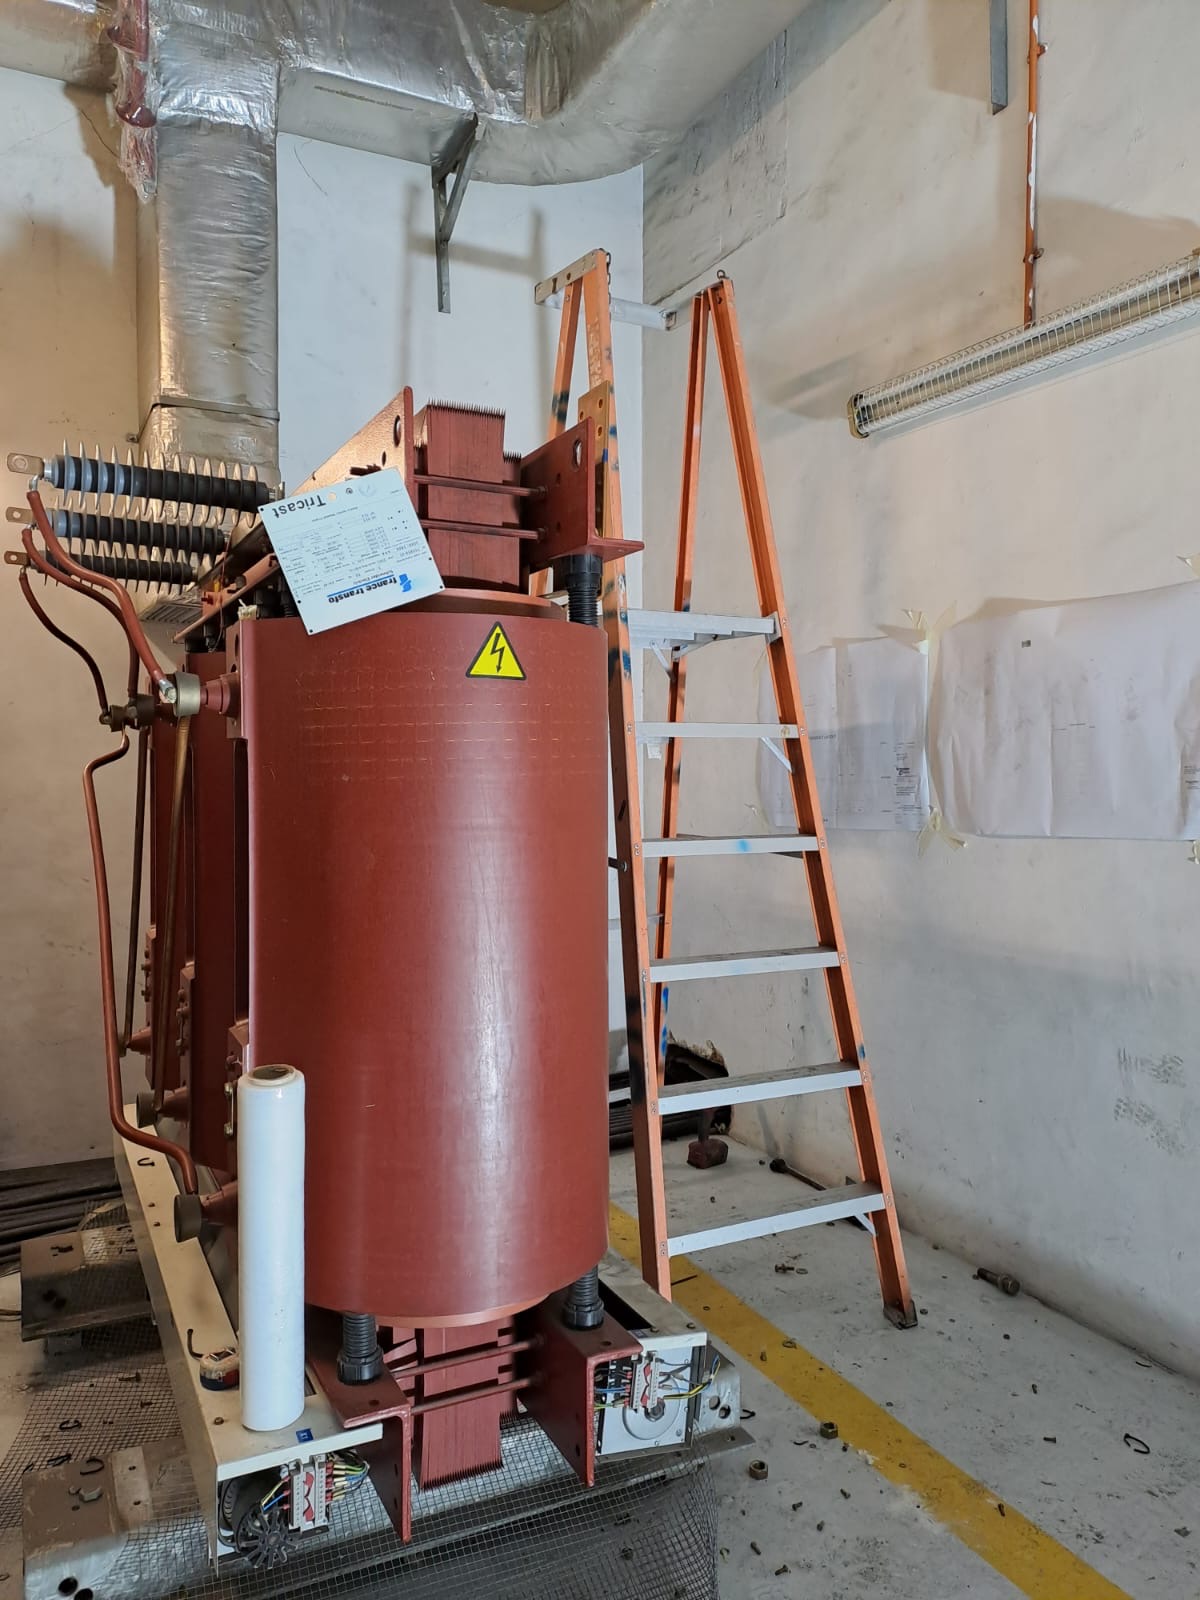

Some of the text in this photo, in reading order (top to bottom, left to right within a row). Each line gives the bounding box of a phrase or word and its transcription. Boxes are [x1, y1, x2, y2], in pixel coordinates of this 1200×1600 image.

[272, 495, 326, 518] Tricast
[366, 577, 397, 591] france
[328, 587, 365, 603] transfo
